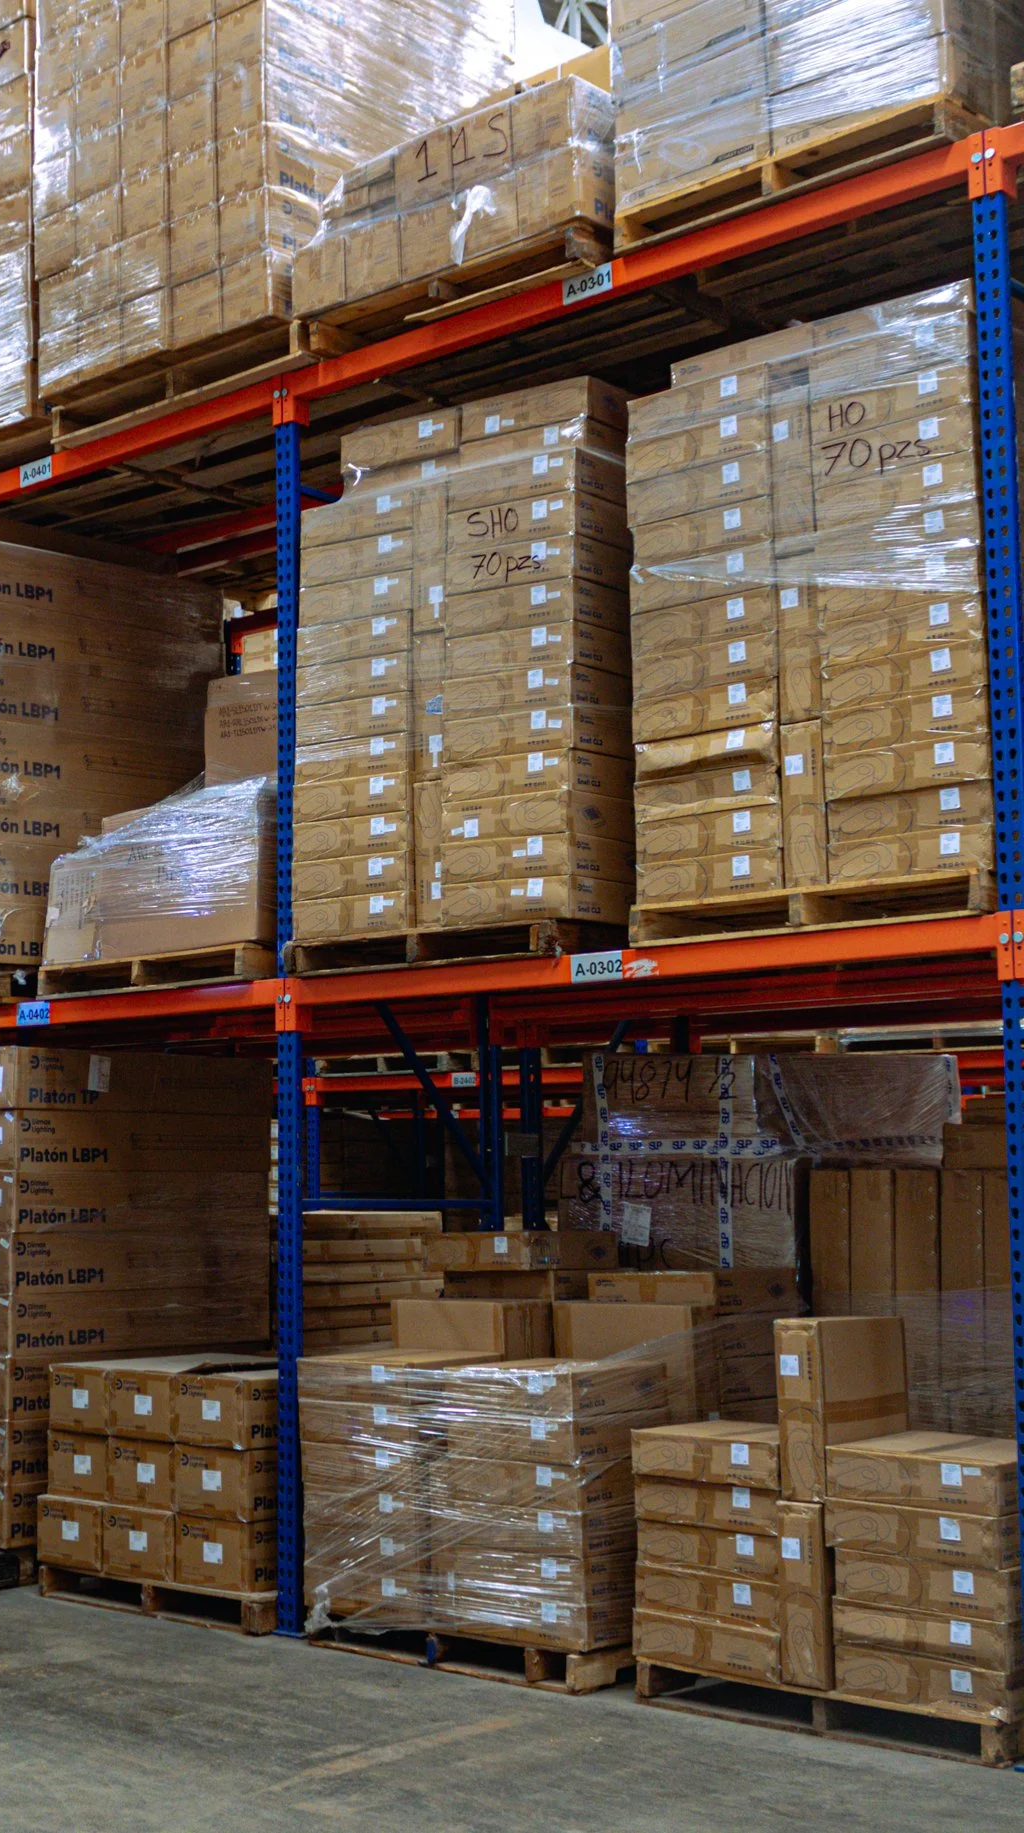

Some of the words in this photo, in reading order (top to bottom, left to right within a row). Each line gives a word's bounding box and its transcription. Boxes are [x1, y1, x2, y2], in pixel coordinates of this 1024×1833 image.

[828, 401, 866, 432] HO
[467, 507, 519, 539] SHO
[16, 582, 53, 602] LBP1
[18, 642, 56, 661] LBP1
[22, 701, 59, 721] LBP1
[23, 760, 61, 779] LBP1
[23, 820, 60, 838] LBP1
[29, 1087, 75, 1104] Platón
[20, 1147, 68, 1163] Platón
[72, 1147, 108, 1163] LBP1
[18, 1207, 66, 1224] Platón
[70, 1207, 106, 1224] LBP1
[15, 1269, 64, 1287] Platón
[68, 1267, 104, 1284] LBP1
[16, 1331, 64, 1349] Platón
[69, 1328, 105, 1345] LBP1
